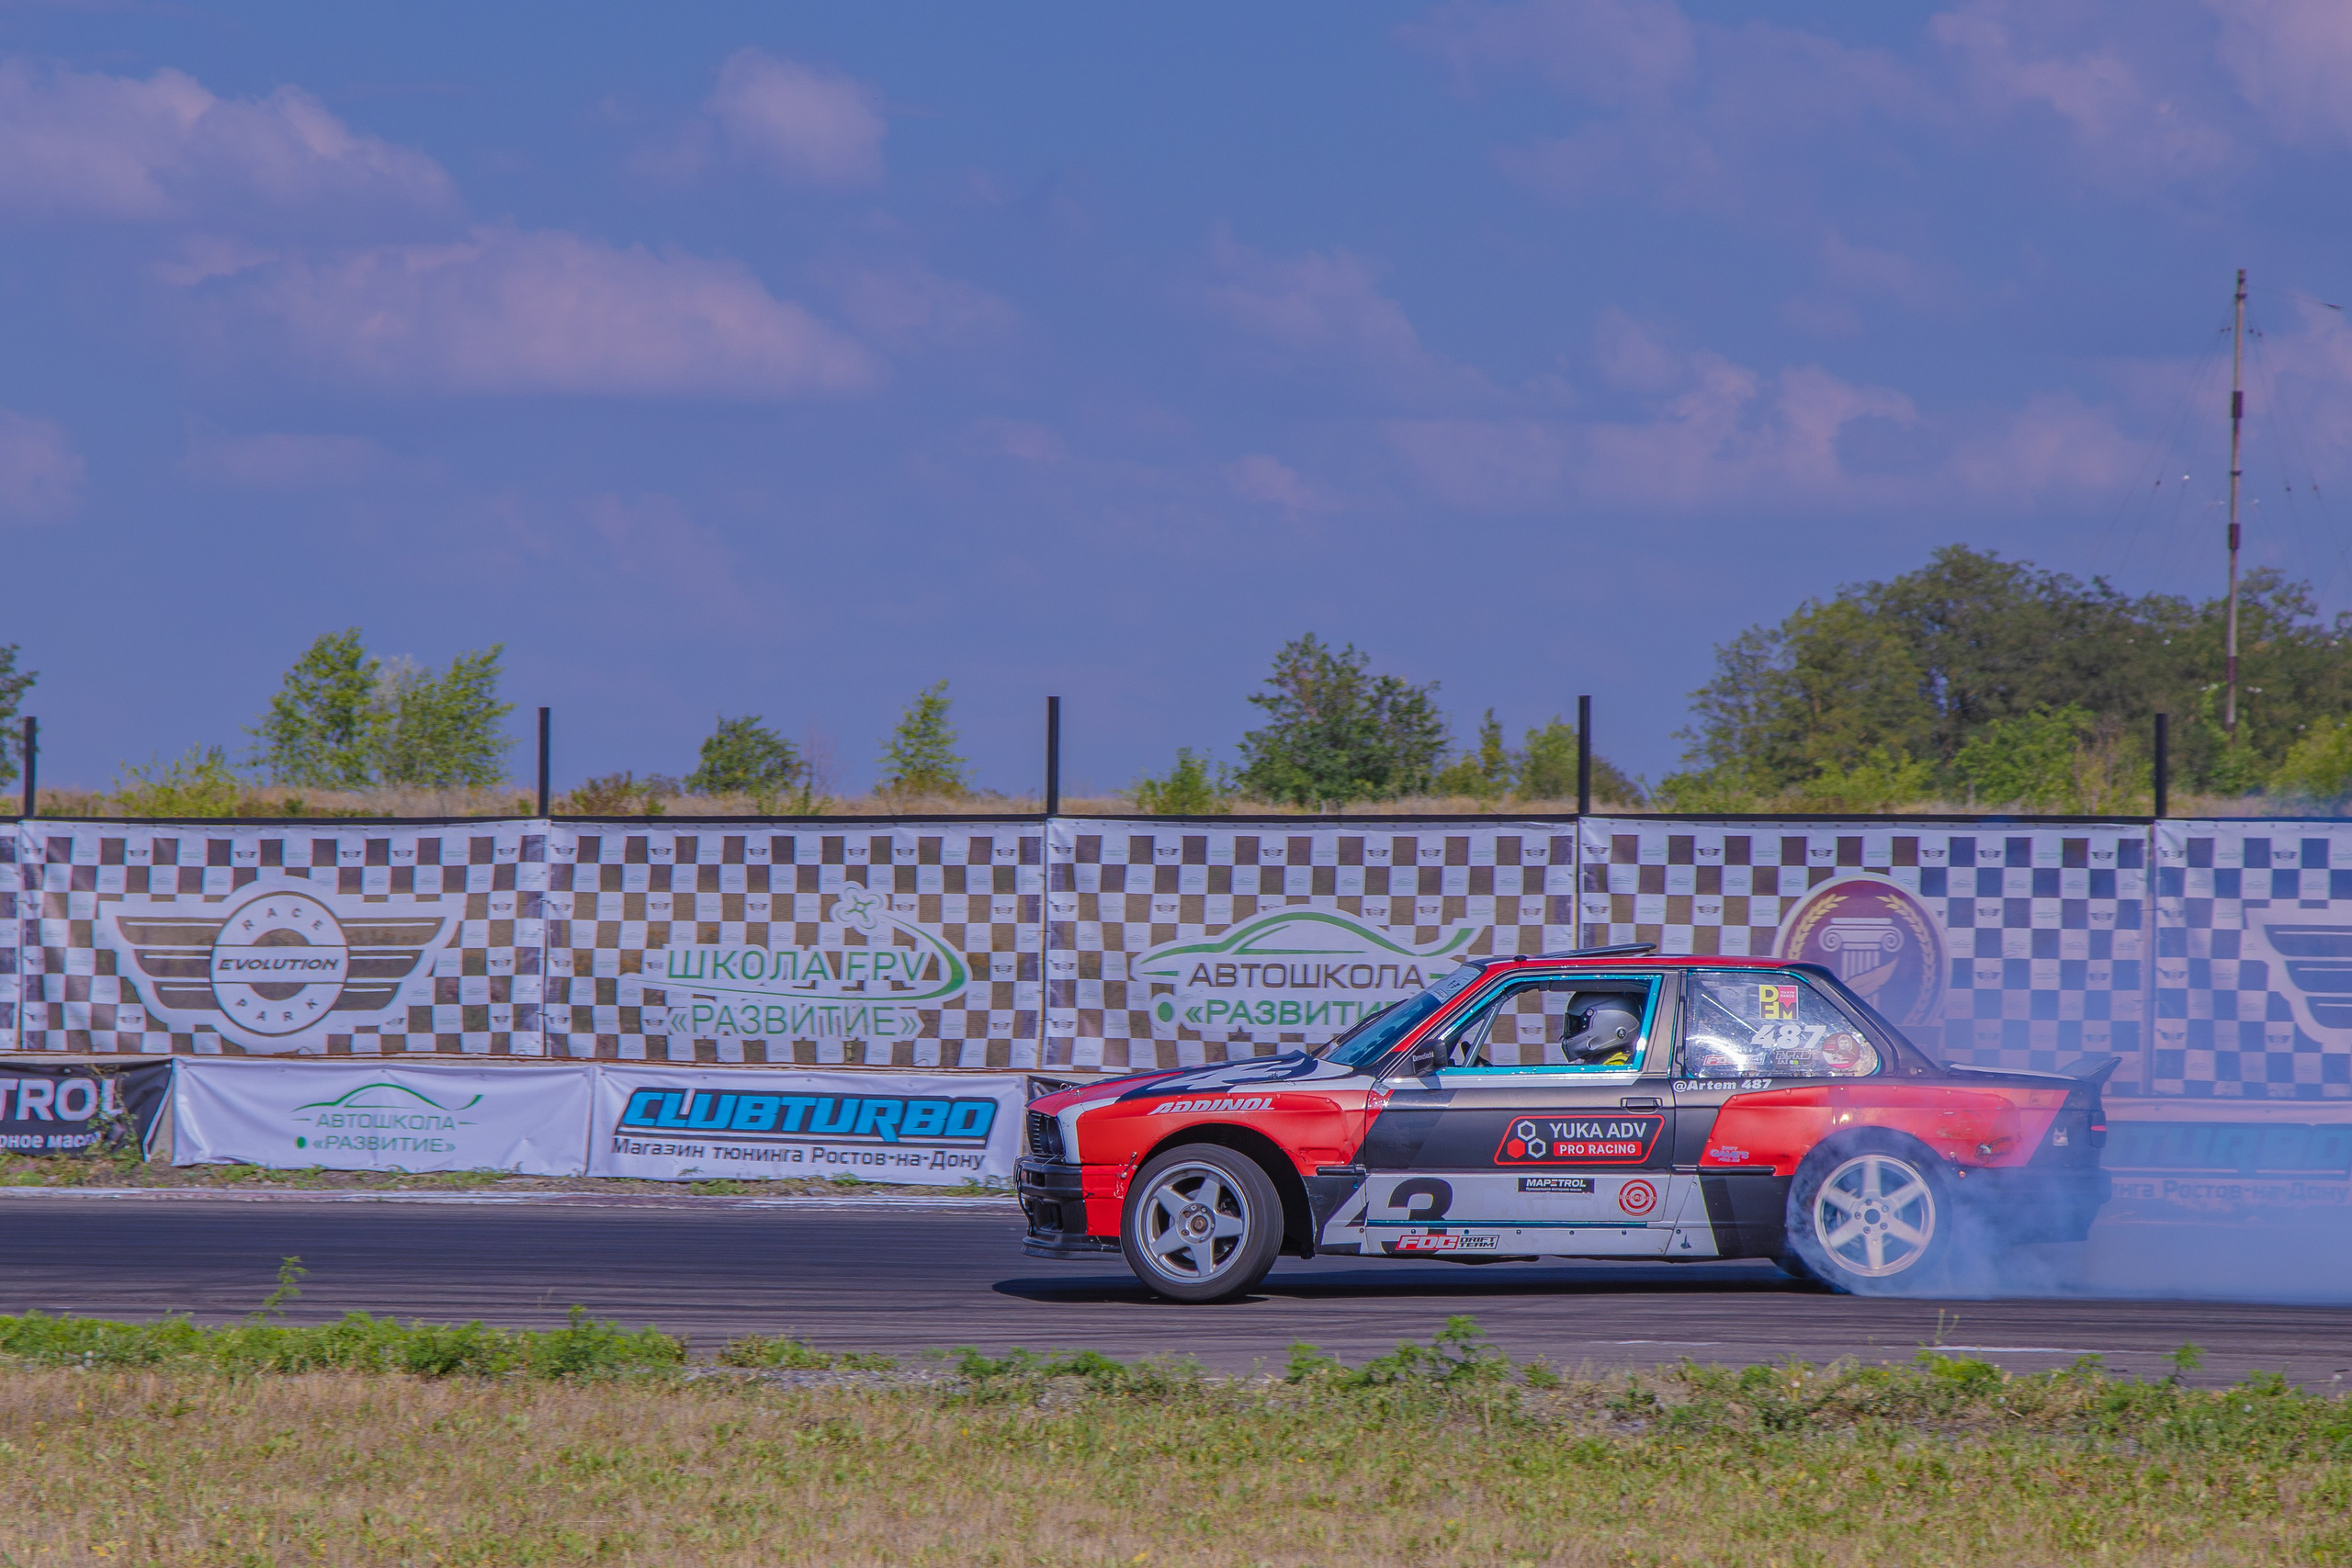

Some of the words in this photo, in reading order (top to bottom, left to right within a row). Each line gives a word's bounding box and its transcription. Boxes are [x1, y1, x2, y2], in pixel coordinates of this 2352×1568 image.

[242, 908, 323, 931] RACE
[218, 958, 339, 970] EVOLUTION
[667, 950, 829, 981] ШКОЛА
[847, 951, 926, 981] FPV
[1187, 963, 1425, 989] АВТОШКОЛА
[235, 998, 319, 1021] PARK
[669, 1004, 918, 1035] «РАЗВИТИЕ»
[1751, 1024, 1826, 1049] 487
[1673, 1079, 1736, 1092] @Artem
[1741, 1078, 1773, 1089] 487
[622, 1091, 997, 1142] CLUBTURBO
[1148, 1098, 1275, 1115] ADDINOL
[315, 1113, 456, 1130] АВТОШКОЛА
[1549, 1122, 1604, 1139] YUKA
[1607, 1122, 1647, 1138] ADV
[312, 1135, 457, 1152] «РАЗВИТИЕ»
[1559, 1144, 1585, 1155] PRO
[1589, 1144, 1636, 1155] RACING
[611, 1137, 705, 1158] Магазин
[711, 1145, 804, 1163] тюнинга
[810, 1146, 987, 1171] Ростов-на-Дону
[1397, 1235, 1458, 1249] FDC
